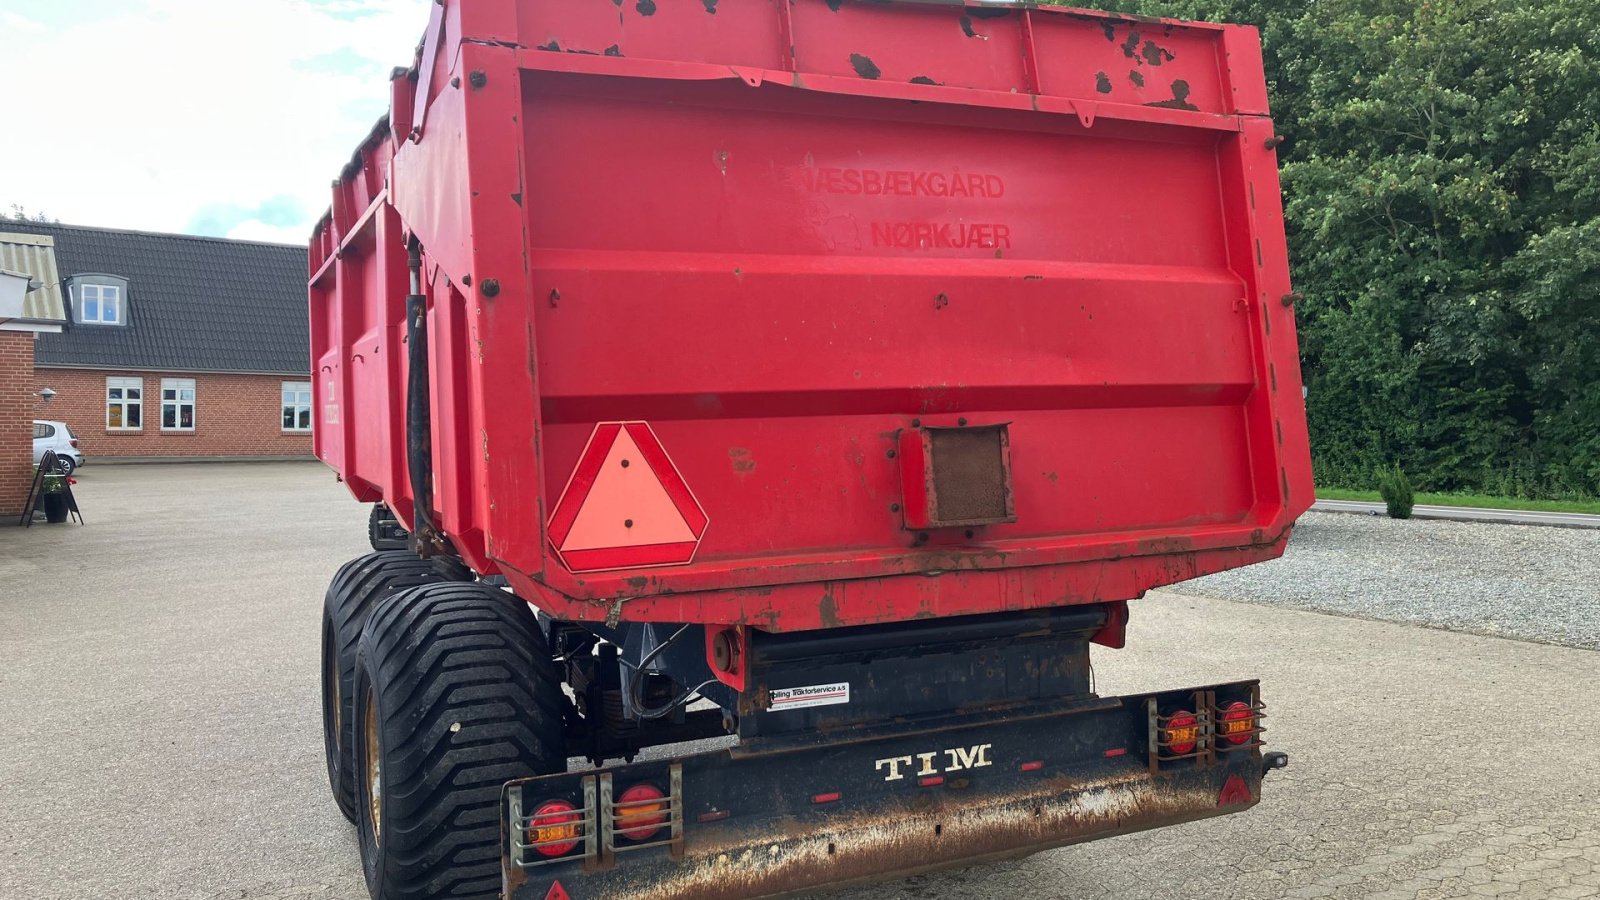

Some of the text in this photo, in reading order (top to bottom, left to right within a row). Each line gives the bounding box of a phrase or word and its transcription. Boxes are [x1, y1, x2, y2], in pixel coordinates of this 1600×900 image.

[871, 221, 1011, 250] NØRKJÆR
[792, 686, 836, 695] Traktorservice
[875, 743, 992, 781] TIM
